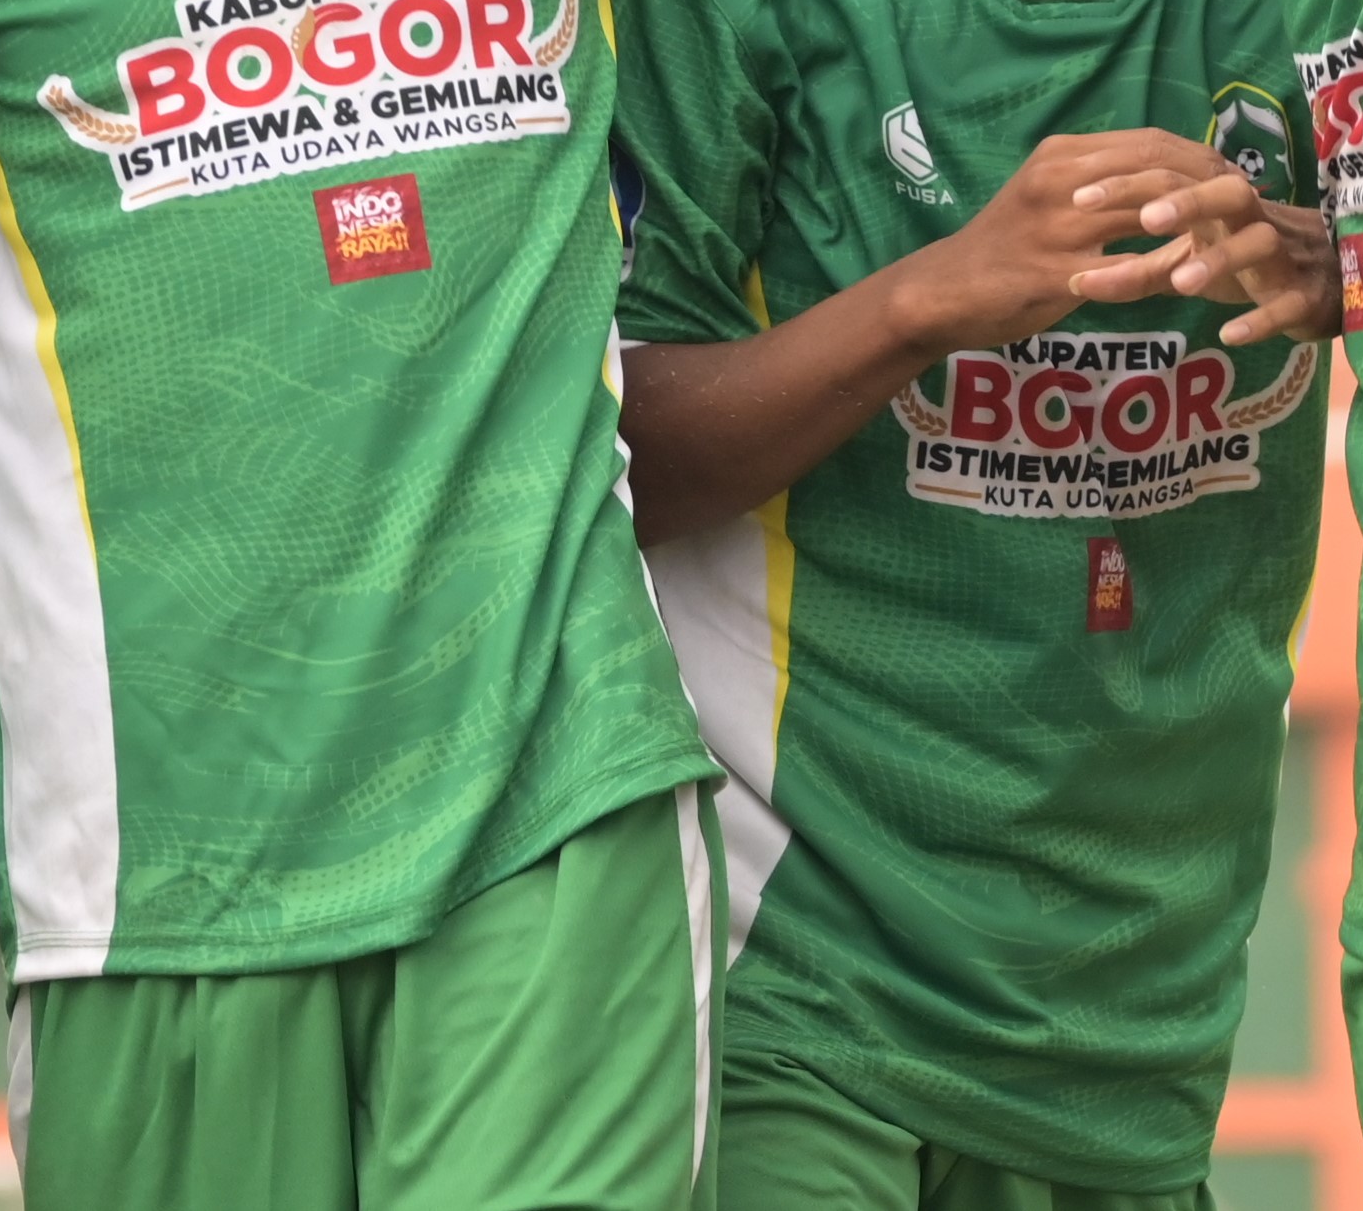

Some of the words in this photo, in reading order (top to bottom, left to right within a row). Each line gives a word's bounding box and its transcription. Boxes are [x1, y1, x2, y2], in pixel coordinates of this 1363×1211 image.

[118, 105, 323, 181] ISTIMEWA
[333, 97, 360, 127] &
[370, 73, 558, 120] GEMILANG
[190, 155, 270, 186] KUTA
[281, 126, 385, 164] UDAYA
[394, 111, 517, 143] WANGSA
[332, 189, 403, 223] INDO
[895, 181, 954, 205] FUSA
[983, 485, 1054, 509] KUTA
